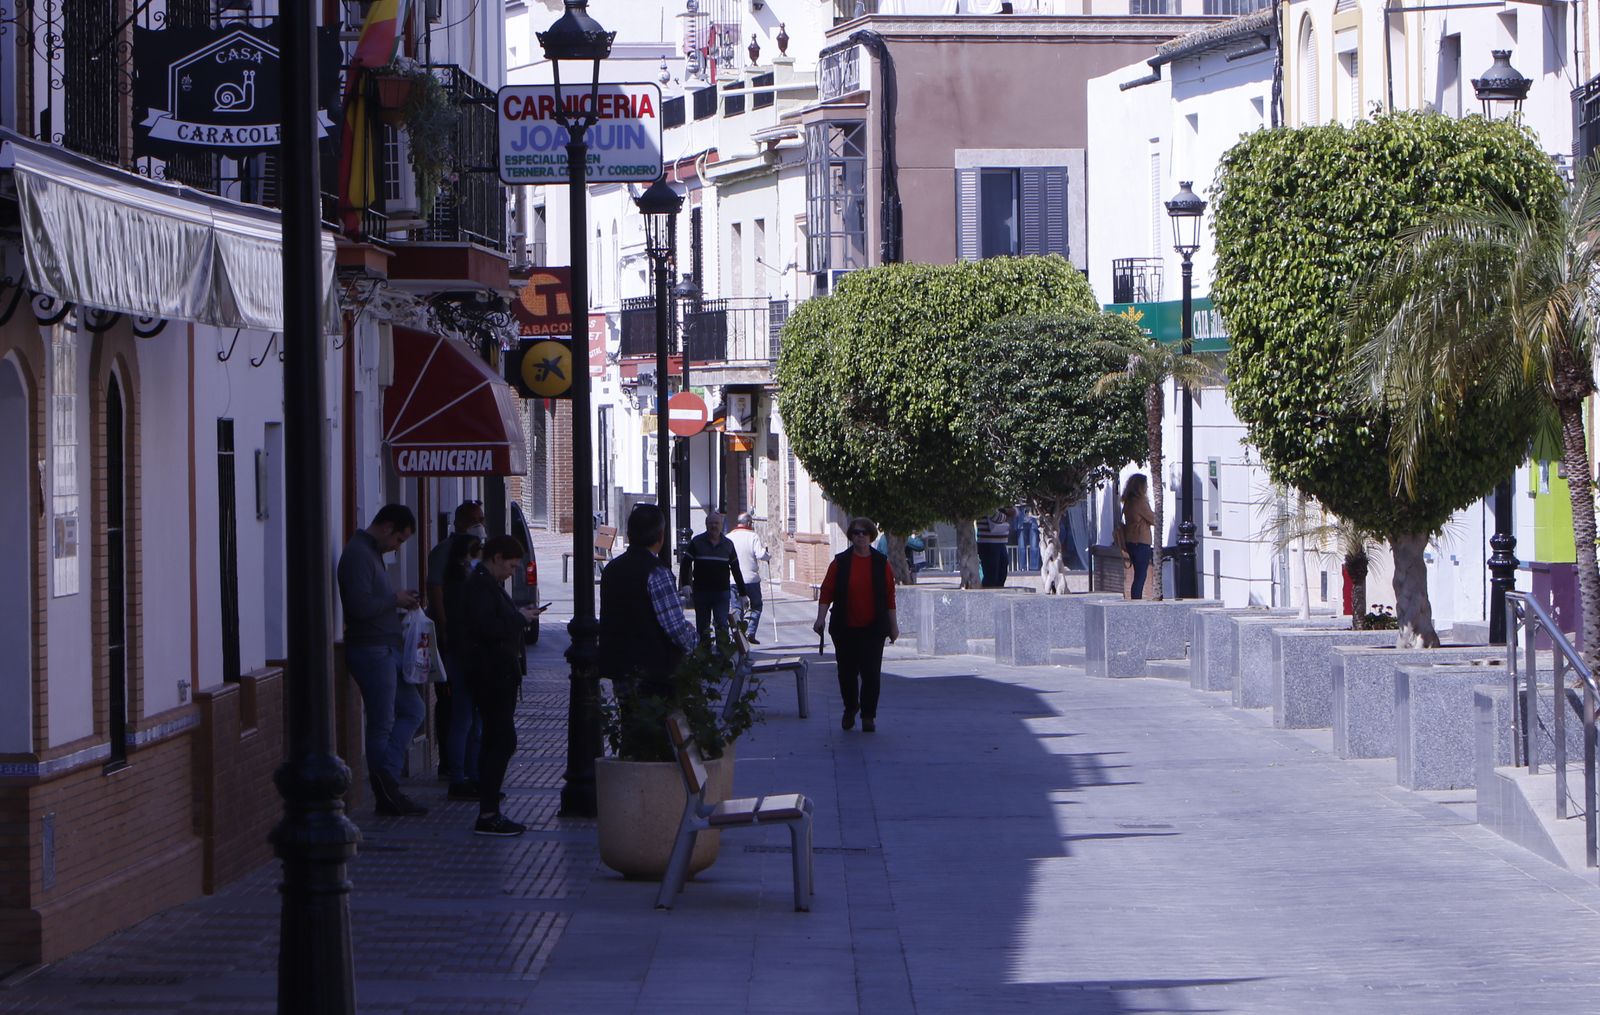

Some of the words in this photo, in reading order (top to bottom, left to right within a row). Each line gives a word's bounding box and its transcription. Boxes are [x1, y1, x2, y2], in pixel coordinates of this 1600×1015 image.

[215, 47, 263, 65] CASA
[177, 124, 281, 144] CARACOL
[505, 154, 568, 165] ESPECIALID
[586, 153, 601, 165] EN
[558, 165, 594, 177] CEO
[597, 165, 606, 176] Y
[608, 165, 657, 176] CORDERO
[398, 449, 493, 472] CARNICERIA
